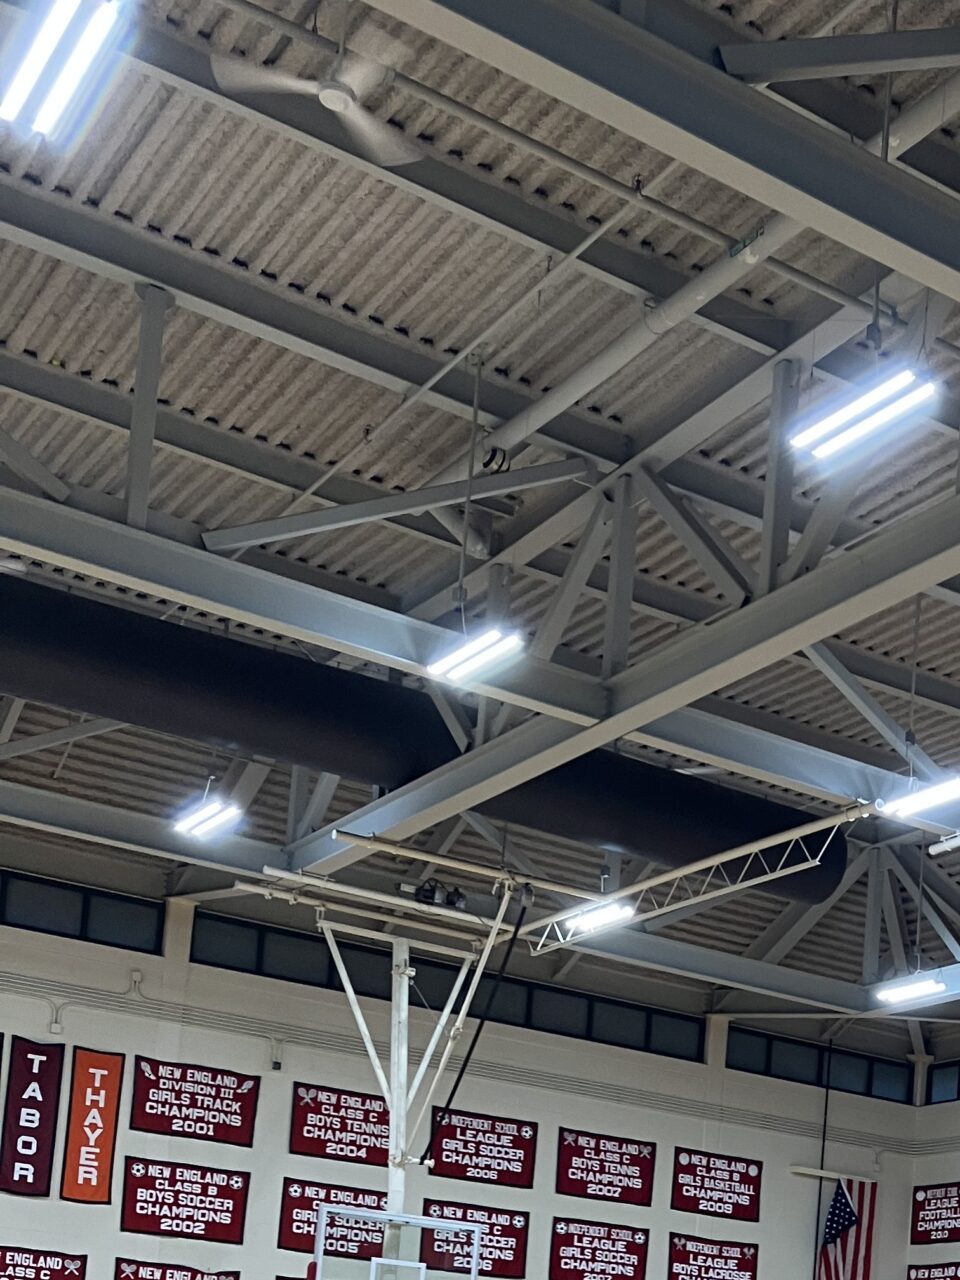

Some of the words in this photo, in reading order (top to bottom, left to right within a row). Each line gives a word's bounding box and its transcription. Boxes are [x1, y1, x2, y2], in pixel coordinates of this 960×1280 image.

[158, 1064, 182, 1079] NEW
[186, 1069, 237, 1088] ENGLAND
[159, 1078, 216, 1096] DIVISION
[219, 1087, 234, 1099] III
[148, 1088, 190, 1105] GIRLS
[194, 1095, 241, 1113] TRACK
[317, 1090, 337, 1104] NEW
[340, 1094, 383, 1112] ENGLAND
[13, 1053, 47, 1183] TABOR
[145, 1101, 242, 1126] CHAMPIONS
[321, 1104, 364, 1120] CLASS
[368, 1112, 378, 1122] C
[77, 1067, 108, 1186] THAYER
[171, 1118, 214, 1135] 2001
[306, 1112, 341, 1129] BOYS
[345, 1119, 389, 1136] TENNIS
[302, 1125, 389, 1149] CHAMPIONS
[456, 1127, 513, 1147] LEAGUE
[325, 1142, 367, 1158] 2004
[441, 1138, 476, 1153] GIRLS
[478, 1144, 524, 1160] SOCCER
[441, 1150, 522, 1172] CHAMPIONS
[147, 1164, 171, 1178] NEW
[175, 1167, 227, 1185] ENGLAND
[465, 1167, 498, 1179] 2006
[155, 1179, 202, 1193] CLASS
[207, 1185, 217, 1195] B
[136, 1187, 174, 1203] BOYS
[177, 1192, 233, 1211] SOCCER
[135, 1201, 231, 1224] CHAMPIONS
[159, 1217, 205, 1234] 2002
[573, 1234, 627, 1252] LEAGUE
[559, 1246, 592, 1259] GIRLS
[594, 1250, 638, 1265] SOCCER
[138, 1266, 162, 1280] NEW
[560, 1258, 634, 1276] CHAMPIONS
